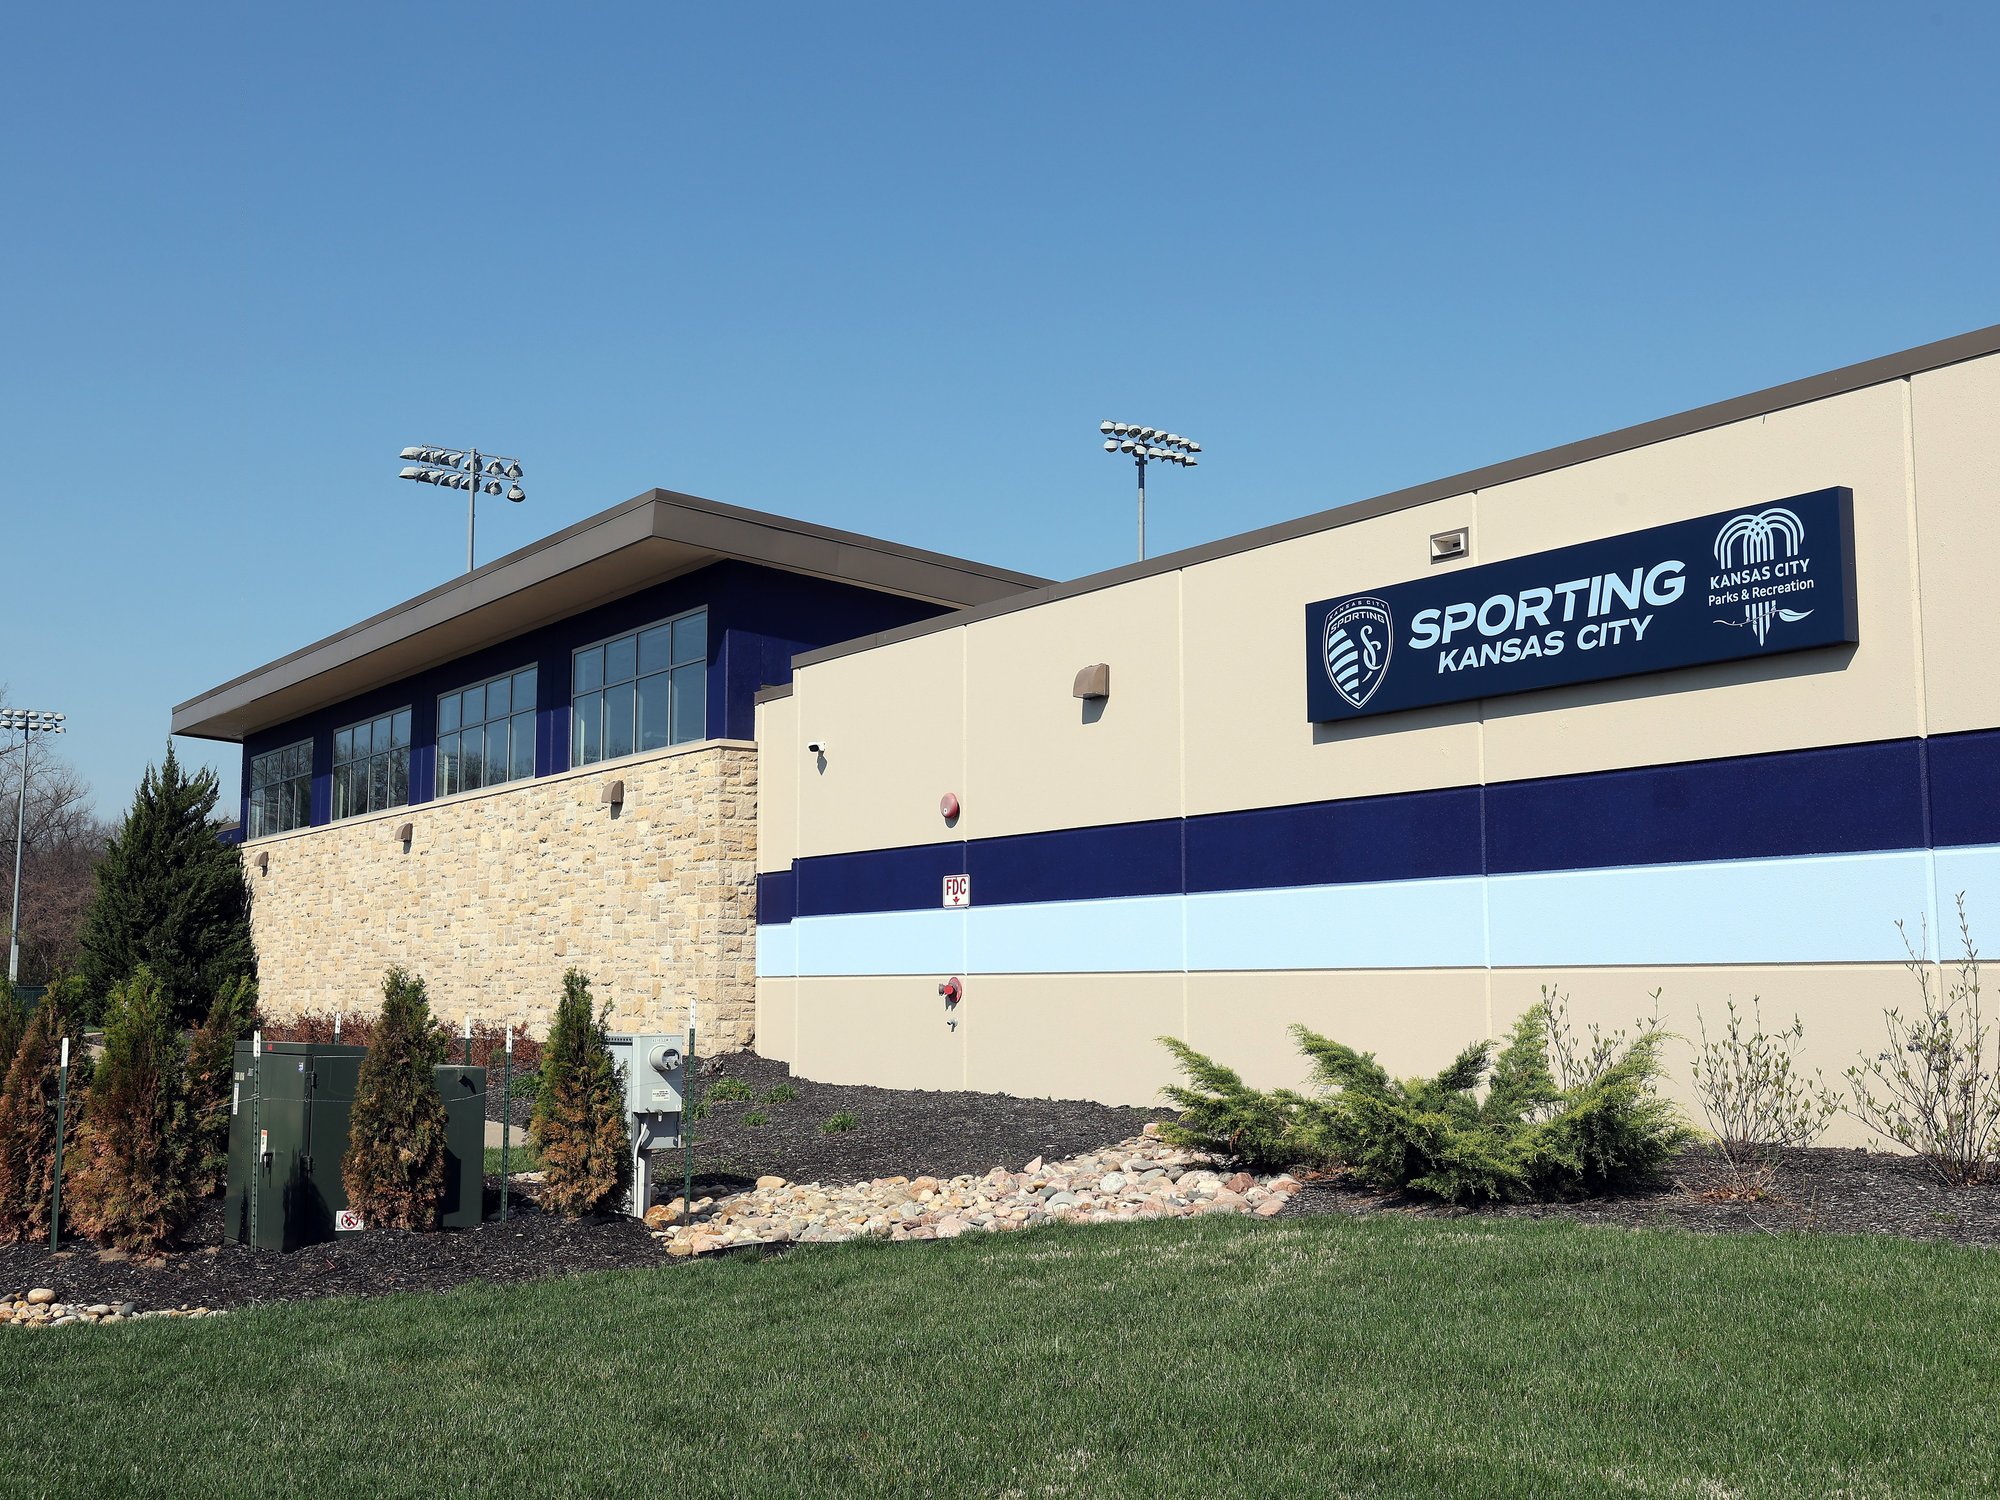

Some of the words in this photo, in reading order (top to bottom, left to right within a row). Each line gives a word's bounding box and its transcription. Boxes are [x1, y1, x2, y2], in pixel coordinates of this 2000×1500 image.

[1711, 566, 1771, 590] KANSAS
[1774, 558, 1810, 577] CITY
[1409, 560, 1686, 650] SPORTING
[1709, 591, 1738, 607] Parks
[1741, 589, 1750, 601] &
[1752, 579, 1814, 599] Recreation
[1329, 601, 1362, 620] KANSAS
[1366, 600, 1385, 609] CITY
[1330, 611, 1385, 635] SPORTING
[1438, 637, 1563, 674] KANSAS
[1577, 615, 1653, 650] CITY
[946, 878, 967, 896] FDC
